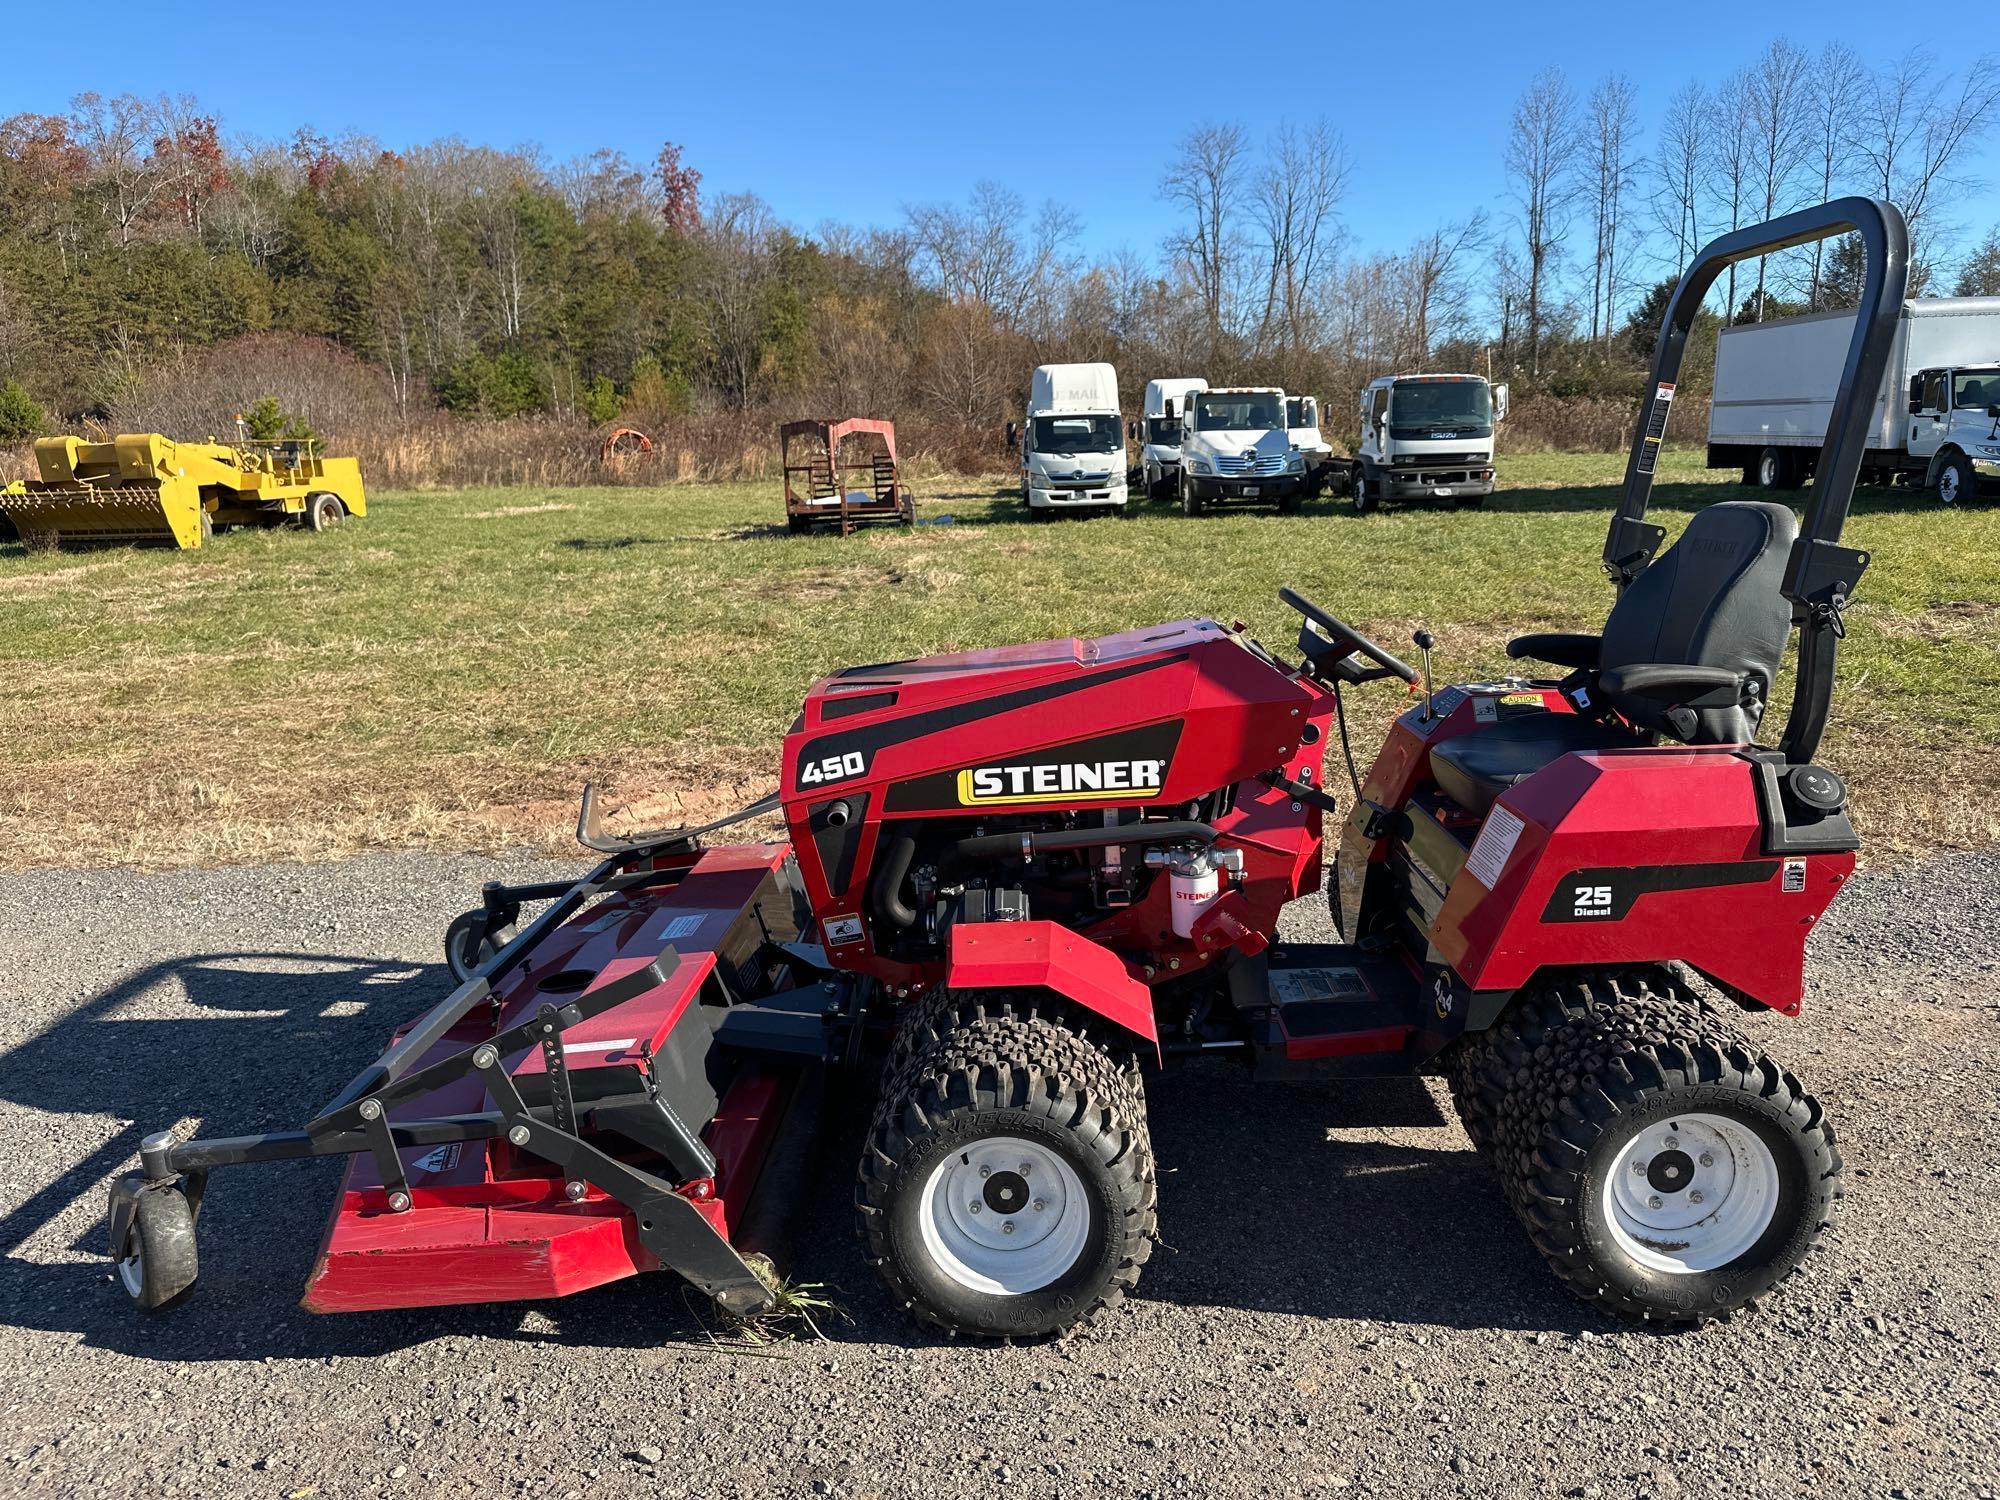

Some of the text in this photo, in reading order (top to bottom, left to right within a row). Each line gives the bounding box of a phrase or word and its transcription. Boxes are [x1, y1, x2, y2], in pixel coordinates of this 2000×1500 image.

[1069, 389, 1100, 400] MAIL
[1502, 695, 1538, 703] CAUTION
[801, 751, 865, 783] 450
[1176, 889, 1216, 901] STEINER
[1574, 886, 1612, 906] 25
[1574, 906, 1611, 916] Diesel
